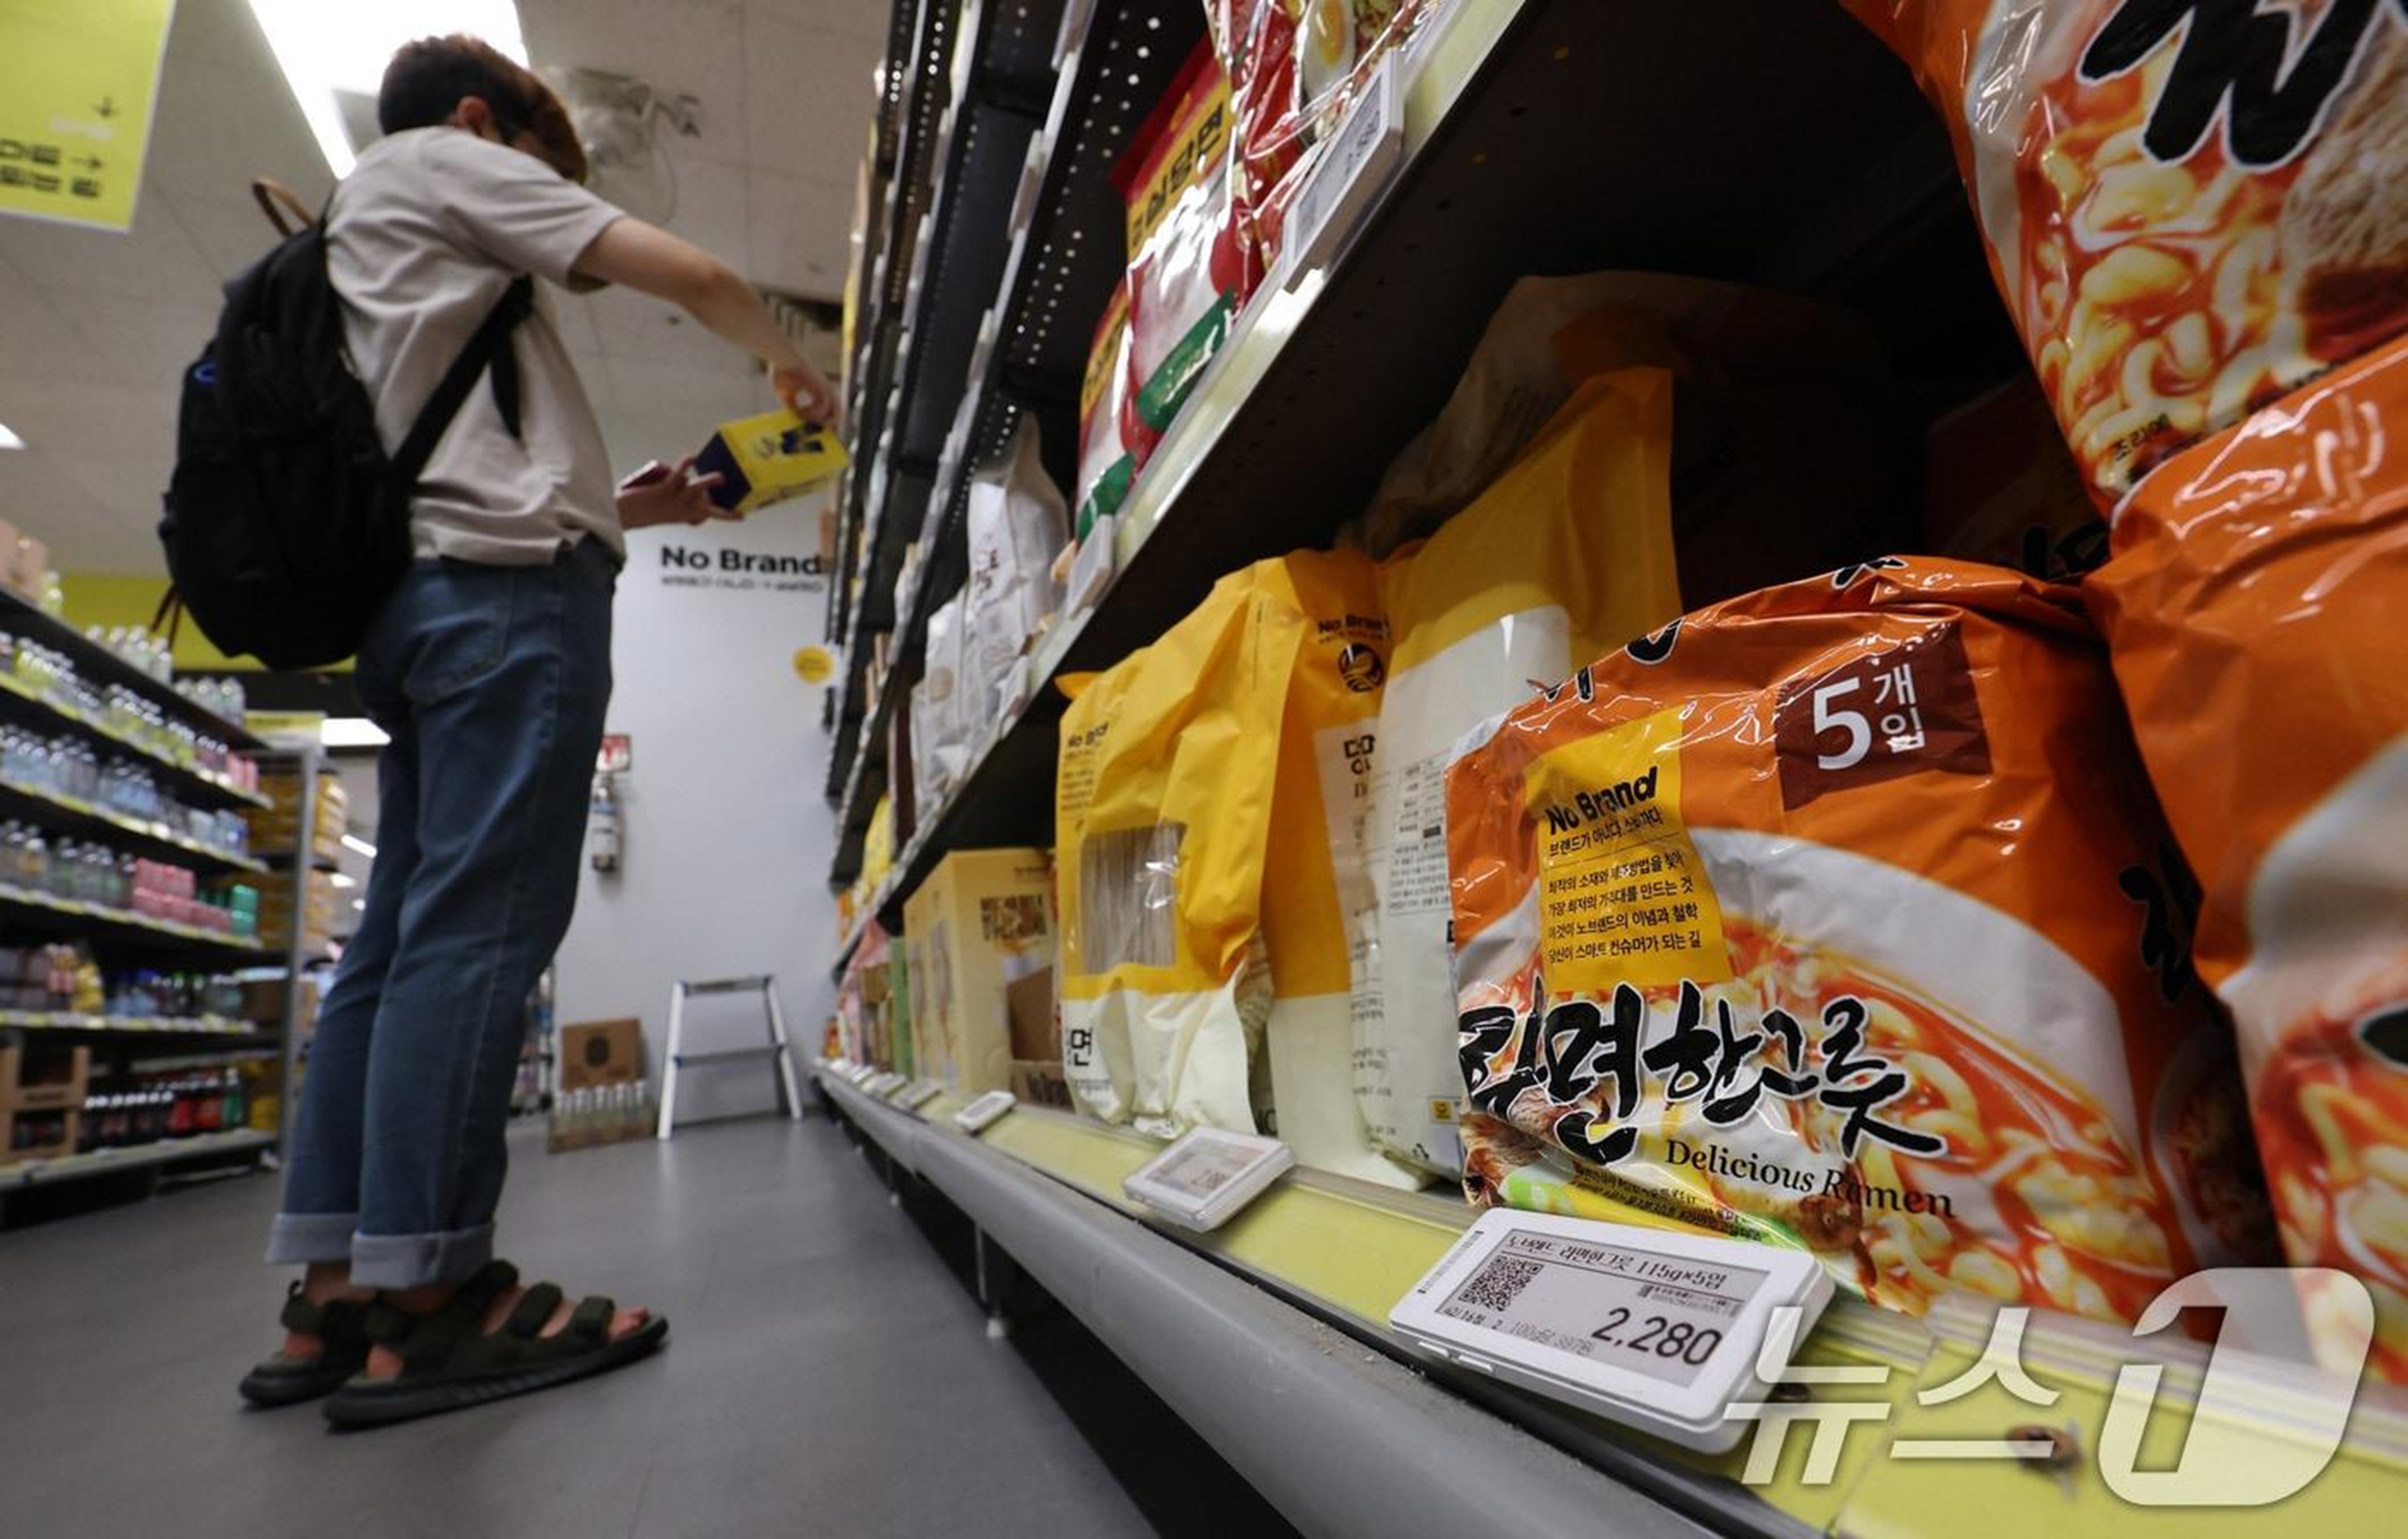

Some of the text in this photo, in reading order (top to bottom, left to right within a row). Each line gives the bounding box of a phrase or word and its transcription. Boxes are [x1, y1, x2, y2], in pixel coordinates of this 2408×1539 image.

[662, 545, 822, 575] No Brand
[1545, 766, 1658, 835] No Brand
[1550, 833, 1591, 857] 브랜드가
[1579, 869, 1609, 888] 소재와
[1640, 881, 1677, 901] 만드는
[1681, 875, 1694, 894] 것
[1632, 907, 1669, 926] 이념과
[1674, 902, 1698, 923] 철학
[1575, 941, 1606, 959] 스마트
[1610, 937, 1659, 956] 컨슈머가
[1662, 933, 1686, 950] 되는
[1688, 930, 1701, 948] 길
[1665, 1139, 1816, 1193] Delicious
[1591, 1307, 1724, 1366] 2,280
